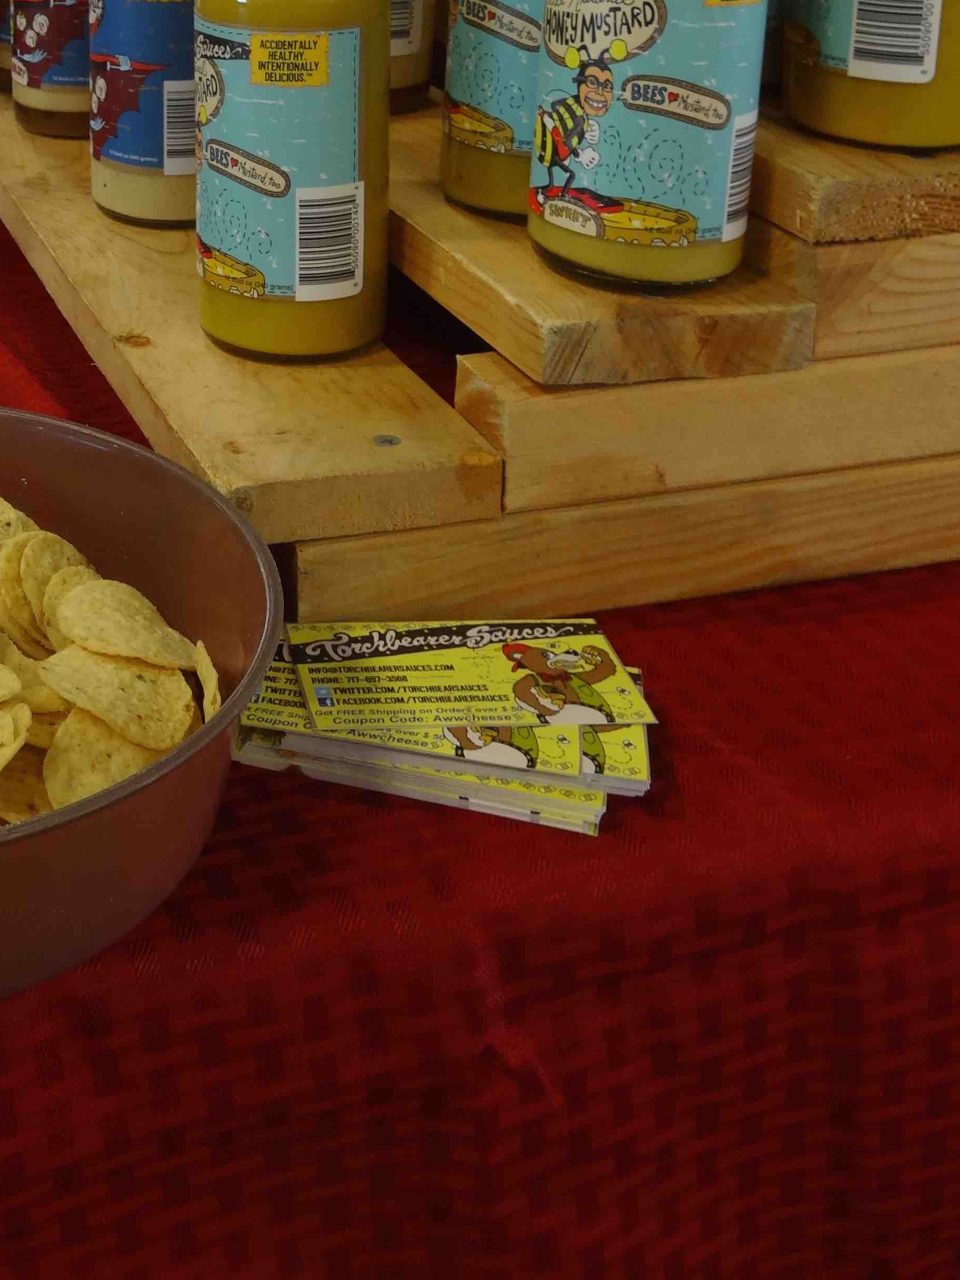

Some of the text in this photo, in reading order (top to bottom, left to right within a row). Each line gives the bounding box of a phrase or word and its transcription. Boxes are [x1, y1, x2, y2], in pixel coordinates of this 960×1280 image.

[465, 0, 488, 21] BEES
[546, 1, 655, 45] HONEY MUSTARD
[196, 35, 235, 59] Sauces
[259, 39, 318, 50] ACCIDENTALLY
[268, 50, 307, 61] HEALTHY.
[258, 61, 320, 71] INTENTIONALLY
[630, 83, 668, 106] BEES
[209, 145, 231, 168] BEES
[305, 625, 564, 661] Torchbearer Sauces
[308, 664, 454, 674] INFO@TORCHBEARERSAUCES.COM
[311, 676, 343, 684] PHONE:
[369, 708, 416, 716] Shipping
[247, 714, 298, 728] Coupon
[333, 717, 385, 725] Coupon
[433, 714, 512, 722] Awwcheese
[346, 728, 429, 747] Awwcheese
[395, 729, 420, 737] over
